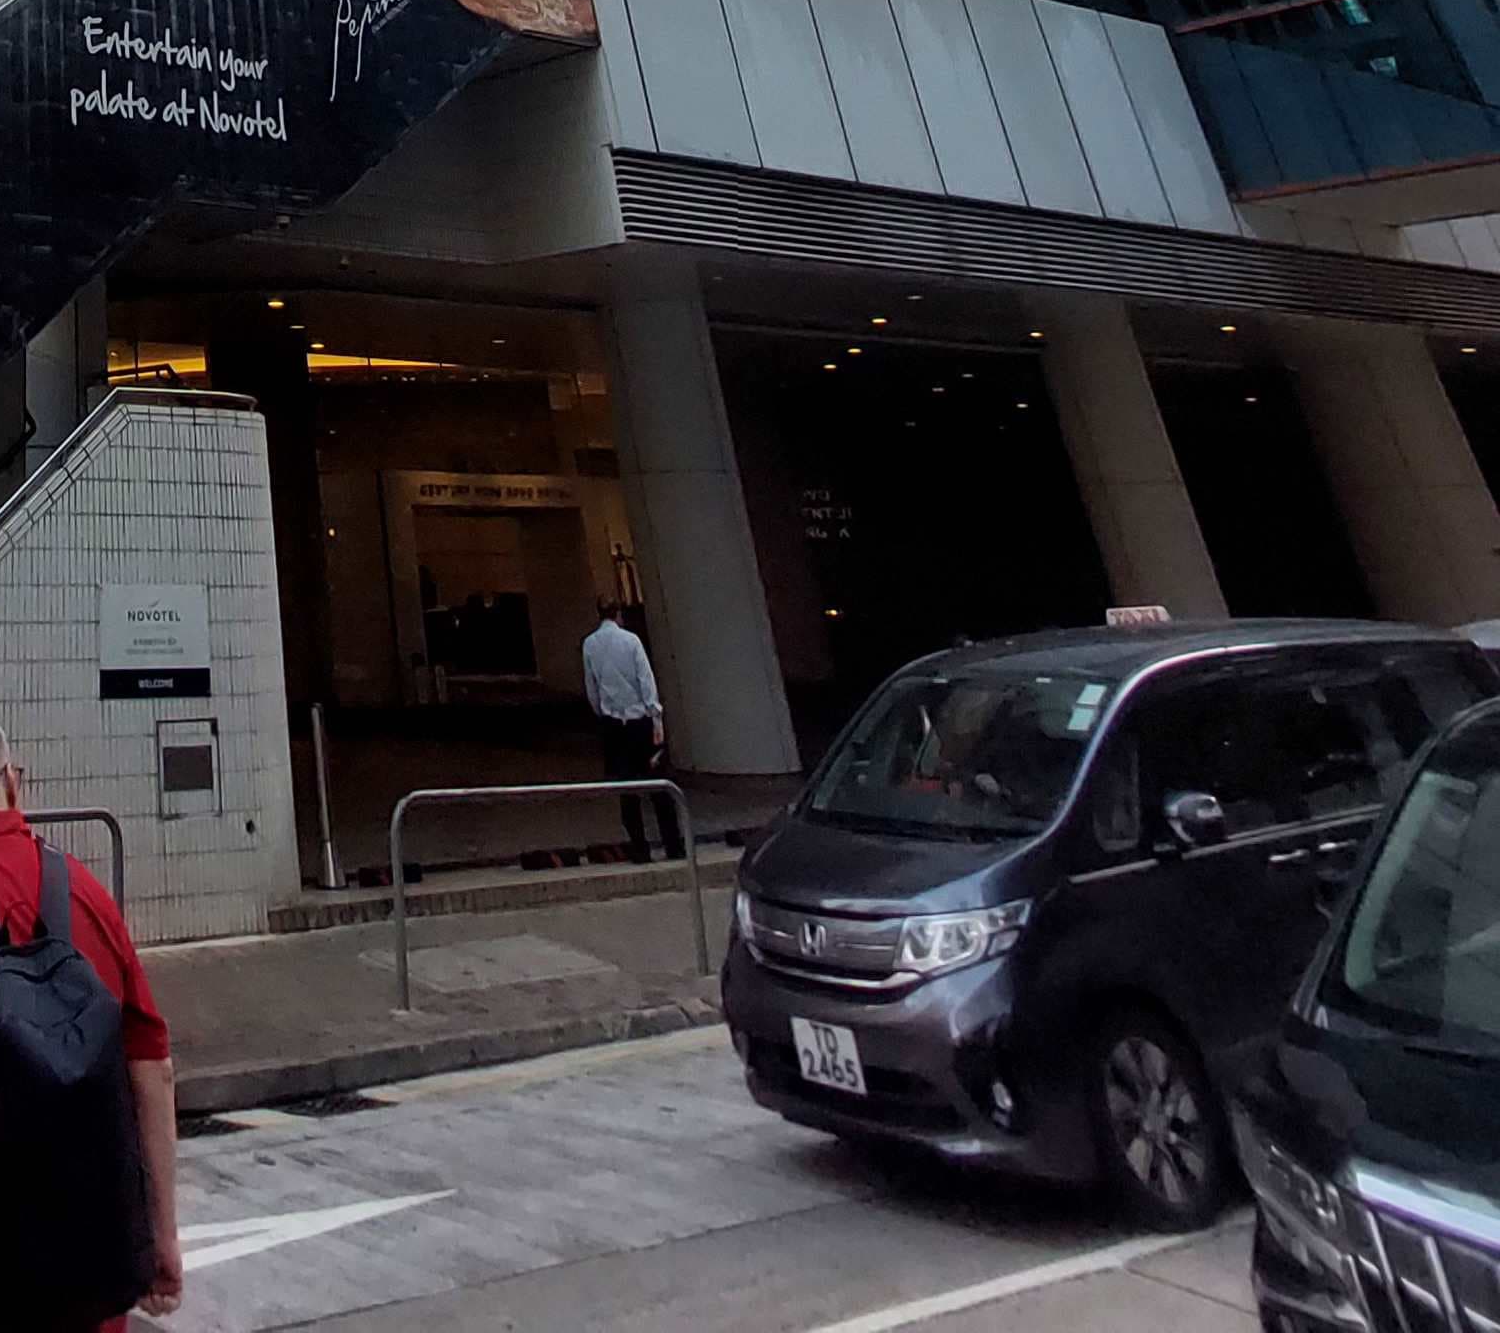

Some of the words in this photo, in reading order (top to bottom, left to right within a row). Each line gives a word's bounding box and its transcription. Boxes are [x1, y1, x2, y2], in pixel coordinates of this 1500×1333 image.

[82, 15, 213, 72] Entertain
[219, 48, 269, 92] your
[70, 68, 157, 126] palate
[162, 88, 196, 127] at
[200, 90, 288, 141] Novotel
[126, 610, 182, 622] NOVOTEL
